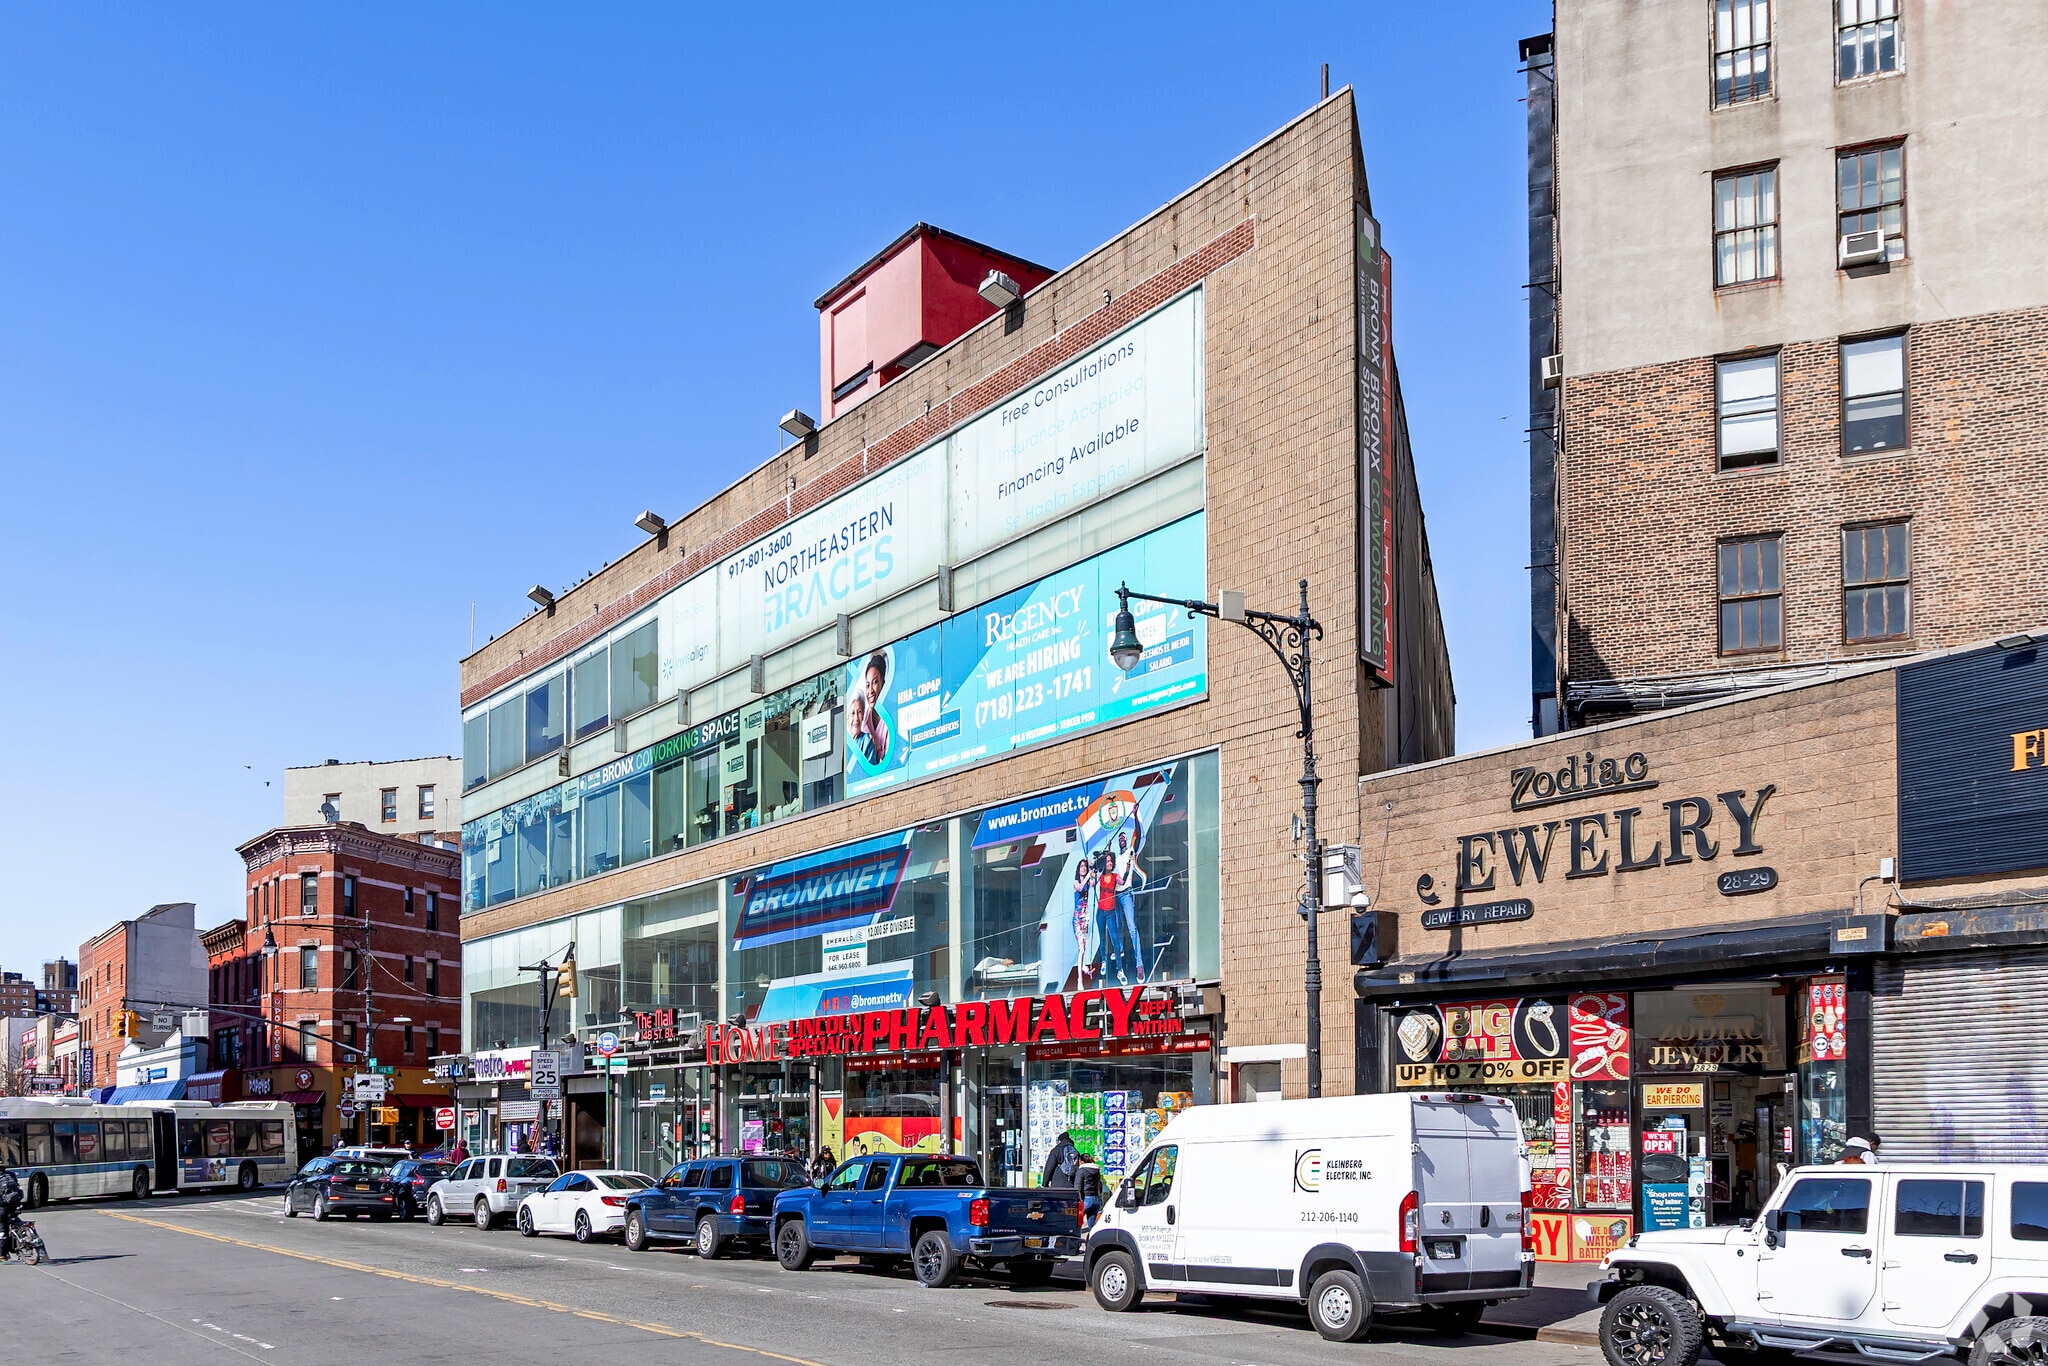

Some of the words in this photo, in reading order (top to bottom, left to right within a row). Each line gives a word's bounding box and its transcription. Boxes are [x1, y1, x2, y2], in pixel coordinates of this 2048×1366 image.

[1370, 278, 1381, 367] BRONX
[1001, 402, 1029, 427] Free
[1034, 342, 1134, 407] Consultations
[1361, 366, 1372, 448] space
[999, 419, 1064, 464] Insurance
[1069, 375, 1144, 426] Accepted
[1370, 372, 1381, 473] BRONX
[998, 456, 1064, 500] Financing
[1069, 418, 1139, 464] Available
[1005, 514, 1019, 532] Se
[1025, 492, 1067, 522] Habla
[1072, 457, 1131, 500] Español
[728, 531, 792, 579] 917-801-3600
[765, 502, 893, 592] NORTHEASTERN
[1370, 477, 1382, 657] COWORKING
[762, 534, 894, 633] BRACES
[984, 584, 1084, 647] REGENCY
[1006, 634, 1030, 652] HEALTH
[1031, 629, 1050, 643] CARE
[986, 668, 1003, 689] WE
[1004, 660, 1025, 683] ARE
[1027, 634, 1080, 675] HIRING
[975, 691, 1013, 728] (718)
[1015, 683, 1044, 713] 223
[602, 757, 634, 784] BRONX
[635, 729, 699, 769] COWORKING
[701, 712, 739, 743] SPACE
[1510, 751, 1650, 812] Zodiac
[987, 793, 1090, 831] www.bronxnet.tv
[748, 860, 897, 915] BRONXNET
[1723, 871, 1770, 890] 28-29
[1425, 906, 1476, 927] JEWELRY
[1484, 901, 1527, 919] REPAIR
[826, 935, 855, 945] EMERALD
[867, 925, 883, 938] 12,000
[882, 923, 889, 934] SF
[890, 918, 914, 933] DIVISIBLE
[828, 954, 840, 962] FOR
[842, 951, 860, 960] LEASE
[851, 992, 902, 1009] @bronxnettv
[1140, 999, 1174, 1015] DEPT
[635, 1012, 652, 1030] The
[655, 1008, 673, 1027] Mall
[787, 1014, 861, 1038] LINCOLN
[861, 986, 1145, 1052] PHARMACY
[1133, 1018, 1183, 1036] WITHIN
[1445, 1003, 1511, 1038] BIG
[1658, 1020, 1764, 1042] ZODIAC
[705, 1023, 781, 1066] HOME
[787, 1033, 862, 1059] SPECIALTY
[1445, 1036, 1511, 1060] SALE
[1648, 1044, 1774, 1066] JEWELRY
[474, 1056, 503, 1075] metro
[535, 1071, 556, 1084] 25
[1400, 1065, 1427, 1081] UP
[1433, 1063, 1460, 1080] TO
[1467, 1061, 1514, 1080] 70%
[1521, 1060, 1565, 1077] OFF
[1647, 1095, 1661, 1105] EAR
[1663, 1094, 1700, 1105] PIERCING
[1656, 1086, 1672, 1094] WE
[1676, 1086, 1691, 1094] DO
[1643, 1139, 1672, 1152] OPEN
[1326, 1160, 1362, 1169] KLEINBERG
[1326, 1171, 1358, 1181] ELECTRIC,
[1359, 1171, 1373, 1181] INC.
[1648, 1190, 1667, 1199] Shop
[1651, 1199, 1665, 1207] Pay
[1301, 1211, 1358, 1223] 212-206-1140
[1590, 1227, 1600, 1235] WE
